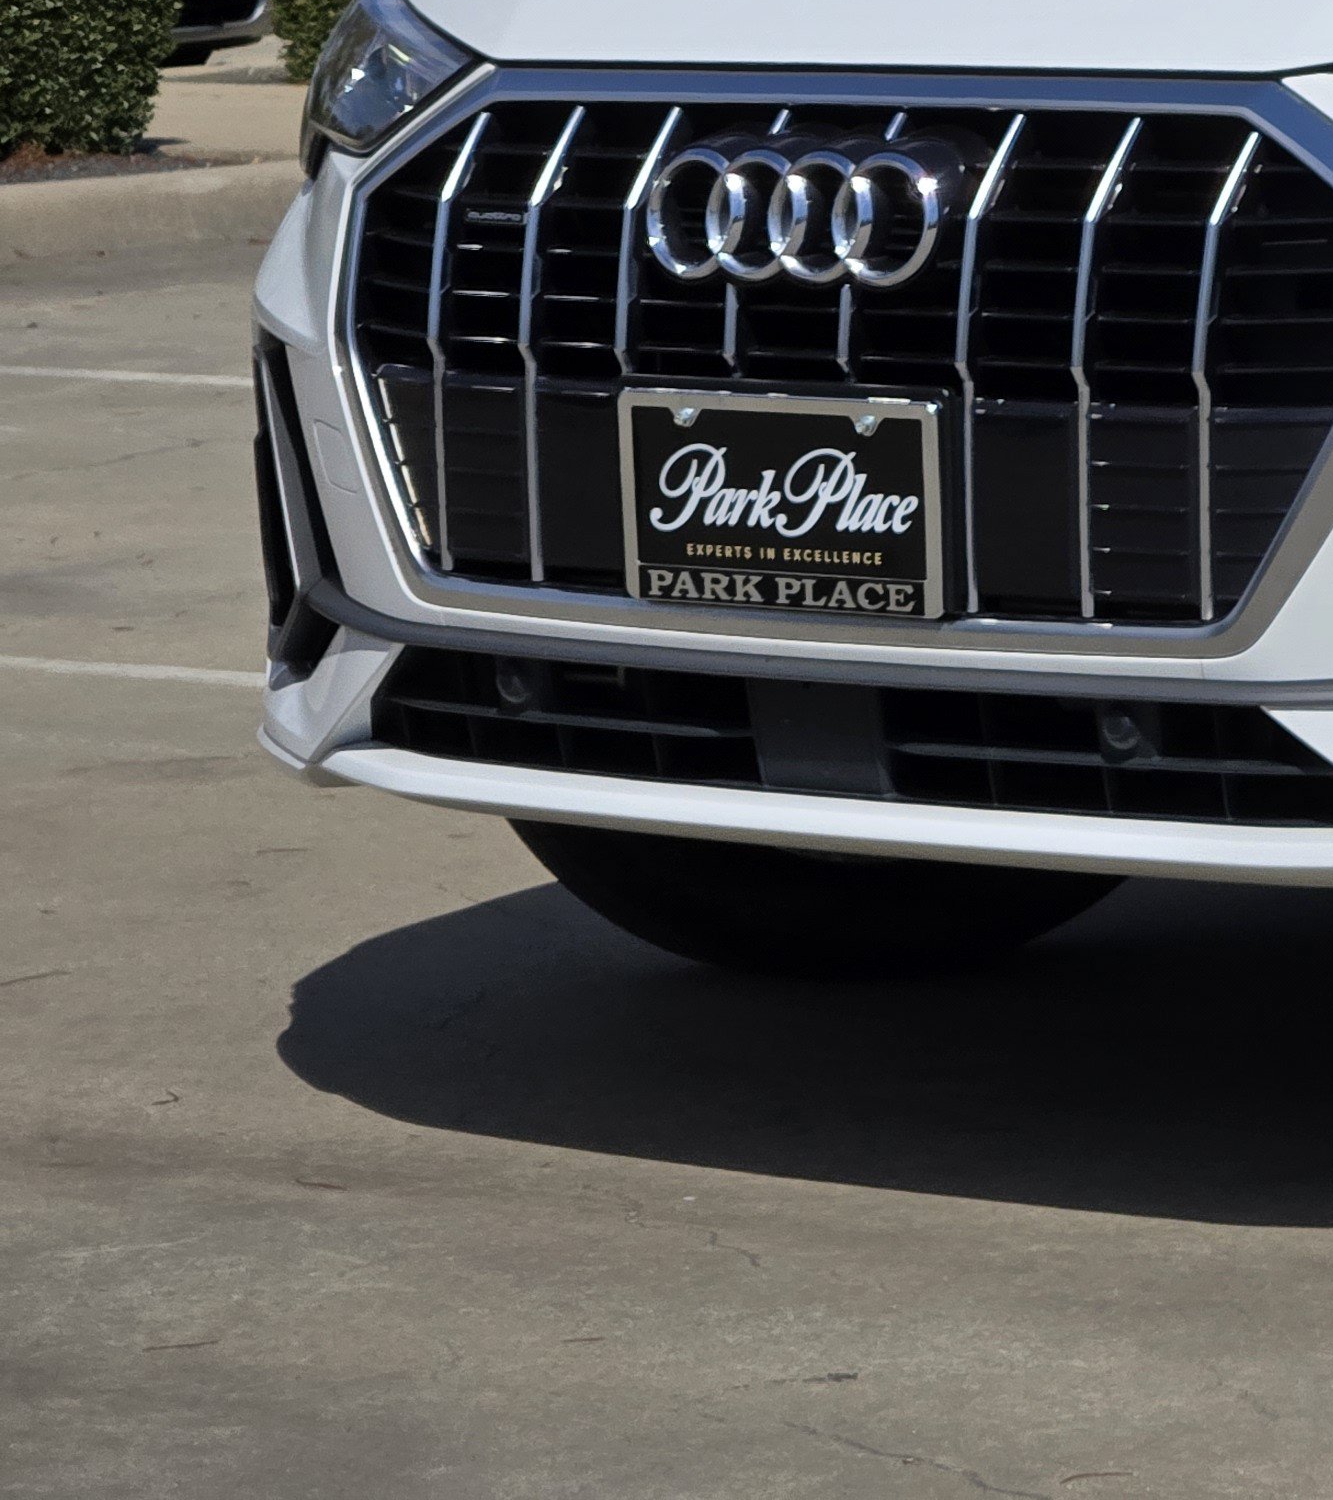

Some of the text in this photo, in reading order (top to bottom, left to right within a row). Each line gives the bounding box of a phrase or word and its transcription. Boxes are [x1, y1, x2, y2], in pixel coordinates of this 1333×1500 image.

[649, 443, 919, 538] Park Place
[686, 543, 883, 565] EXPERTS IN EXCELLENCE
[647, 569, 917, 613] PARK PLACE
